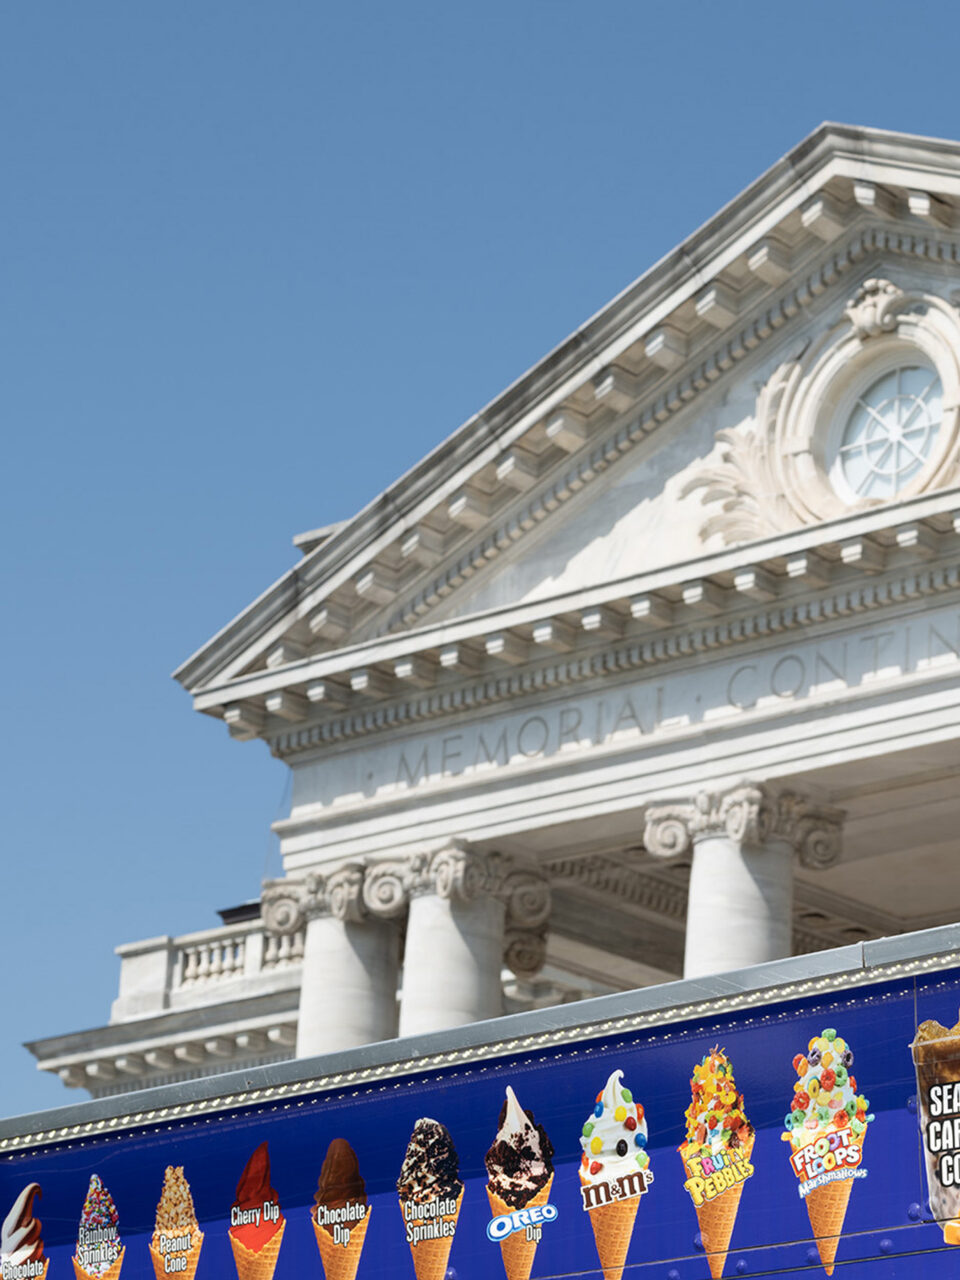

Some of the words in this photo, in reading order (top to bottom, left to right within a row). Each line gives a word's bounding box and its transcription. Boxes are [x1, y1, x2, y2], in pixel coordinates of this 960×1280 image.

[394, 687, 688, 788] MEMORIAL
[793, 1129, 851, 1172] FROOT
[805, 1144, 861, 1178] LOOPS
[685, 1159, 753, 1206] PEBBLES
[799, 1168, 868, 1198] Marshmallows
[231, 1206, 260, 1226] Cherry
[263, 1202, 280, 1224] Dip
[317, 1205, 366, 1225] Chocolate
[404, 1199, 457, 1221] Chocolate
[406, 1220, 456, 1241] Sprinkles
[489, 1206, 557, 1240] OREO
[526, 1224, 542, 1242] Dip
[79, 1227, 116, 1242] Rainbow
[160, 1236, 192, 1253] Peanut
[334, 1225, 350, 1244] Dip
[78, 1246, 118, 1265] Sprinkles
[165, 1256, 187, 1273] Cone
